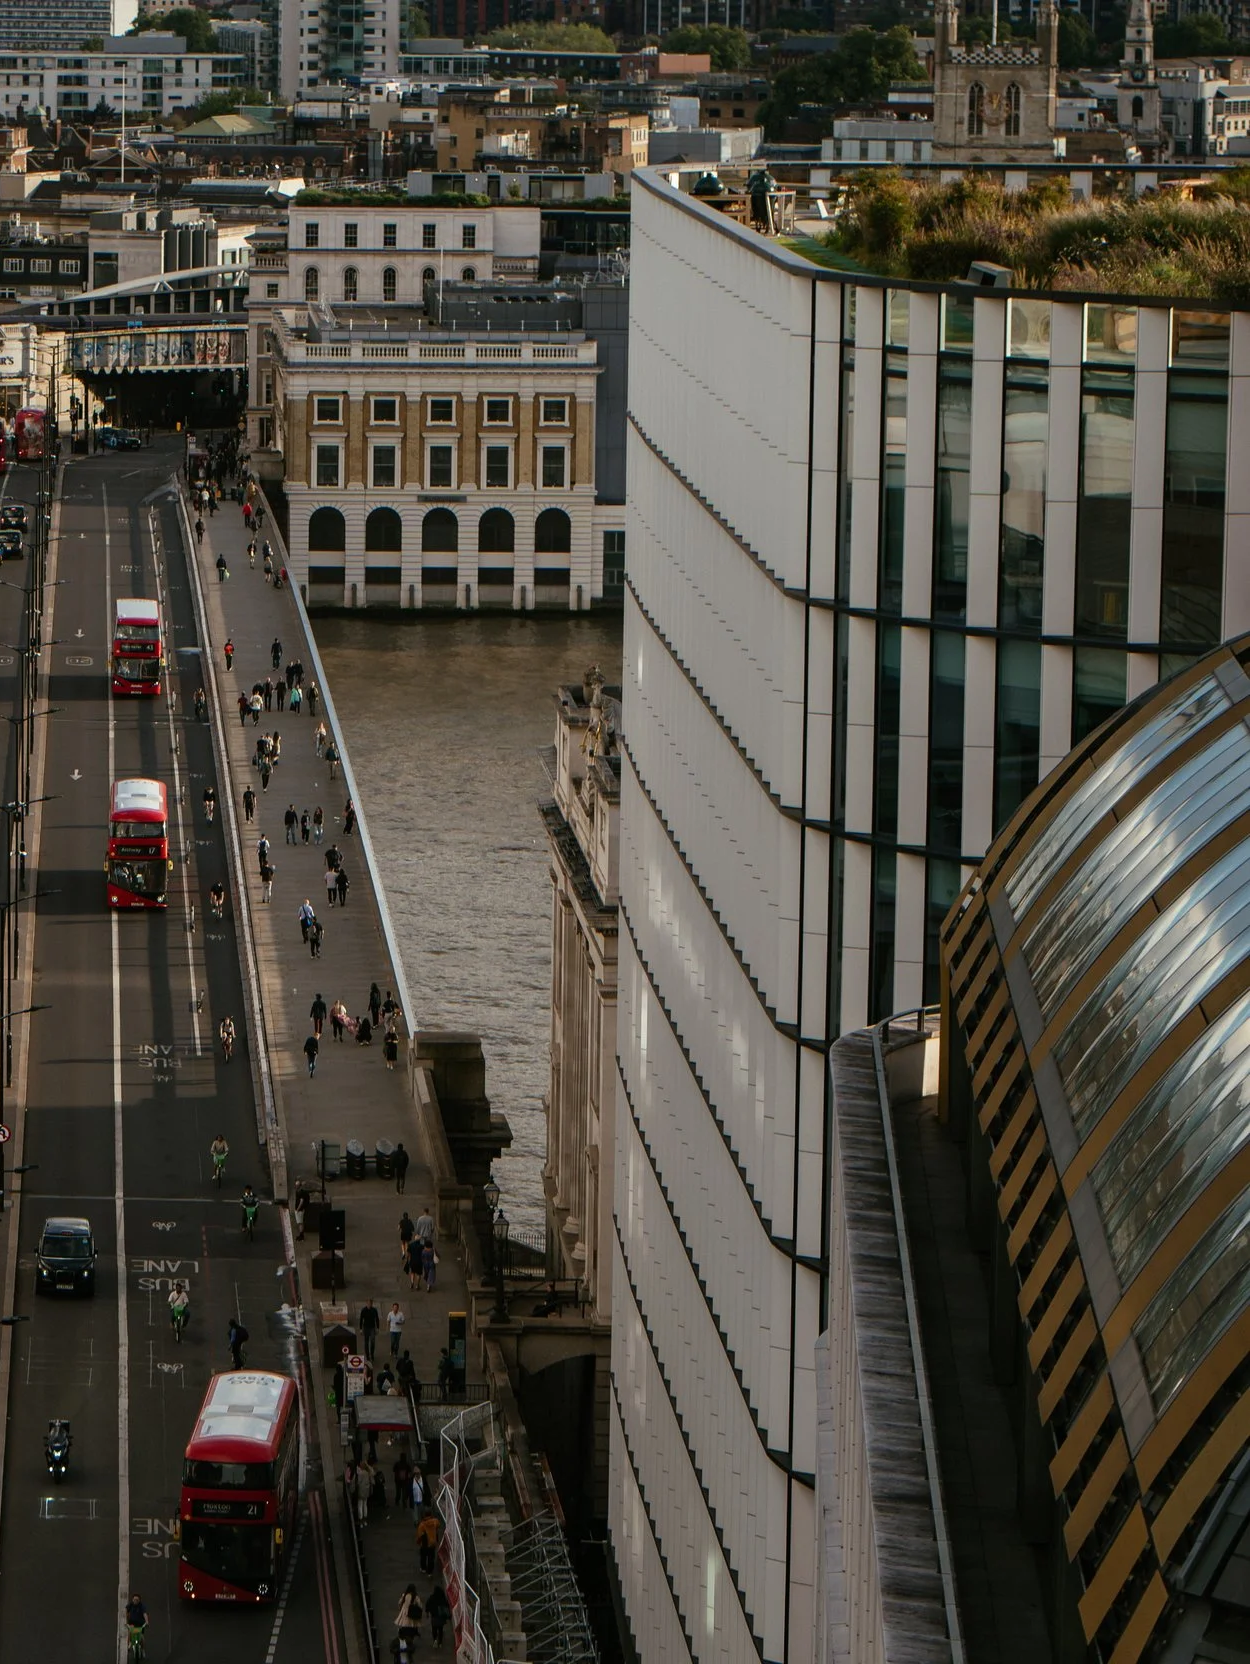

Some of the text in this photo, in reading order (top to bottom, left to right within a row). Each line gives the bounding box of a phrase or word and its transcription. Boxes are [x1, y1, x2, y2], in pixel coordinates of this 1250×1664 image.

[130, 1259, 199, 1273] LANE
[138, 1277, 190, 1291] BUS
[247, 1504, 257, 1516] 21
[132, 1517, 175, 1535] NE
[142, 1541, 180, 1559] US
